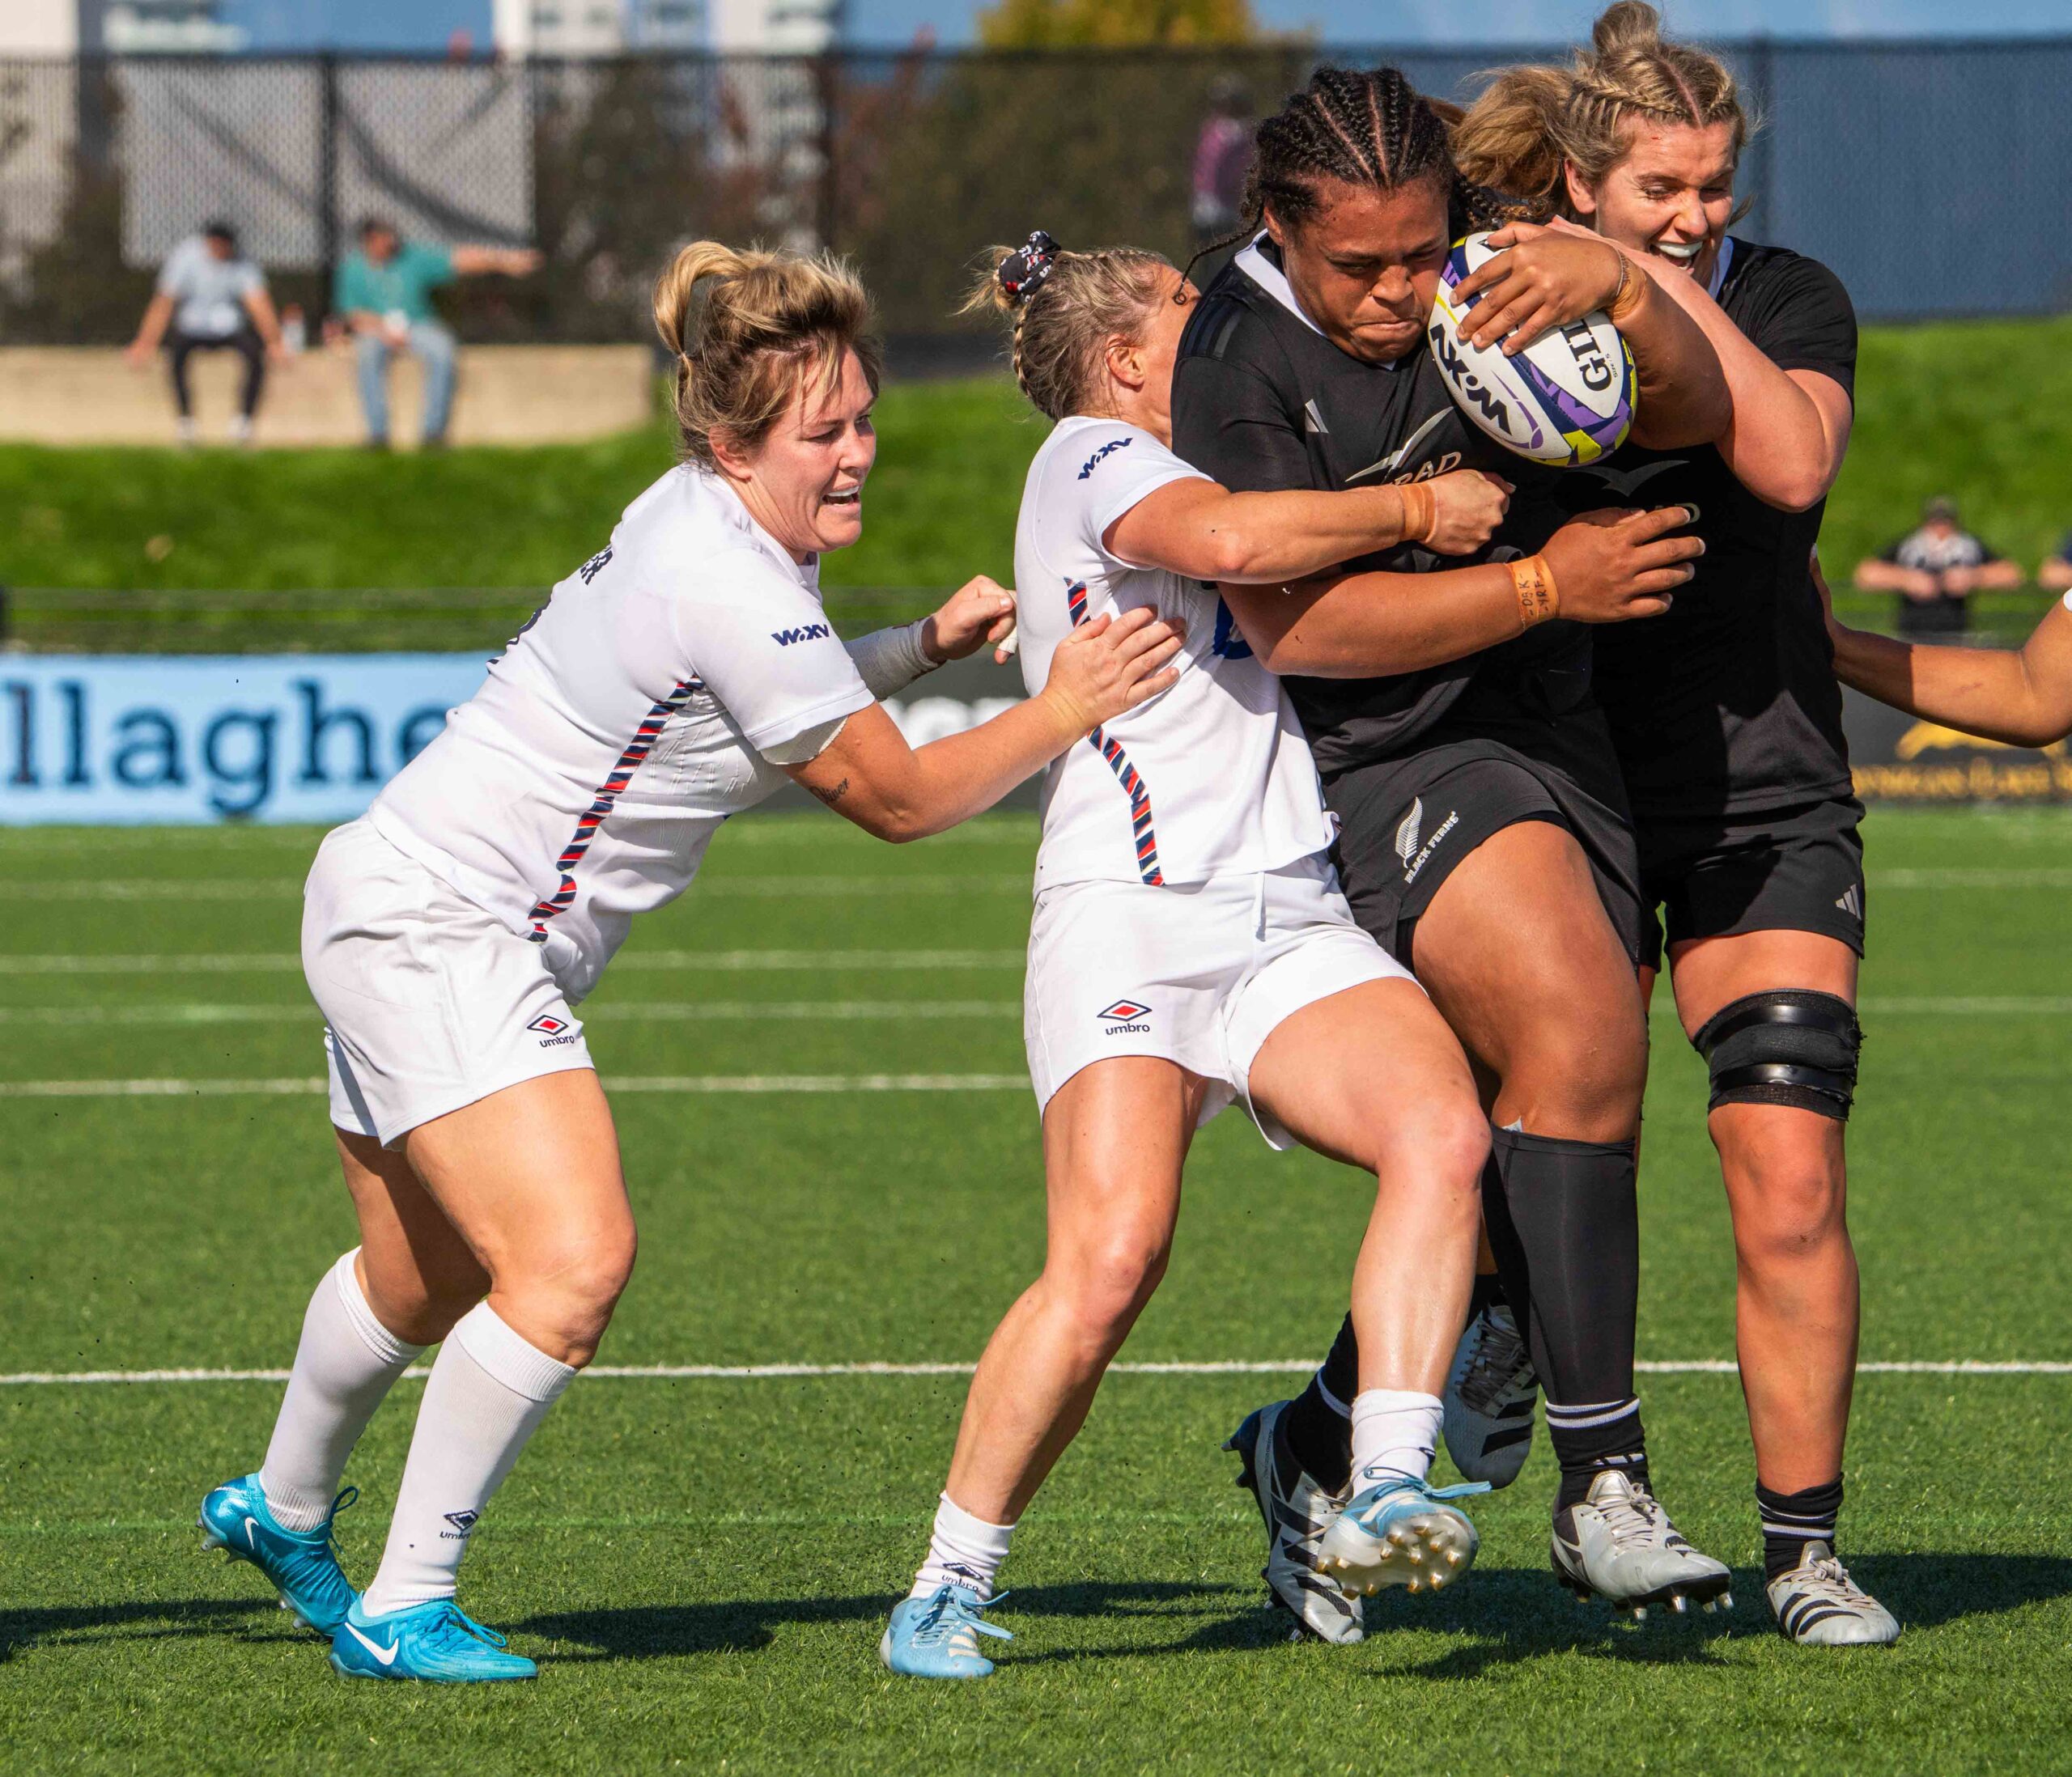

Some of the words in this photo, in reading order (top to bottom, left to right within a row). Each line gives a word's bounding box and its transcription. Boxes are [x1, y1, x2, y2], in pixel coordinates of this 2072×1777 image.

[1390, 452, 1462, 486] RAD
[1403, 846, 1432, 884] BLACK
[1427, 813, 1459, 848] FERNS
[1106, 1022, 1150, 1036] umbro
[539, 1035, 575, 1048] umbro
